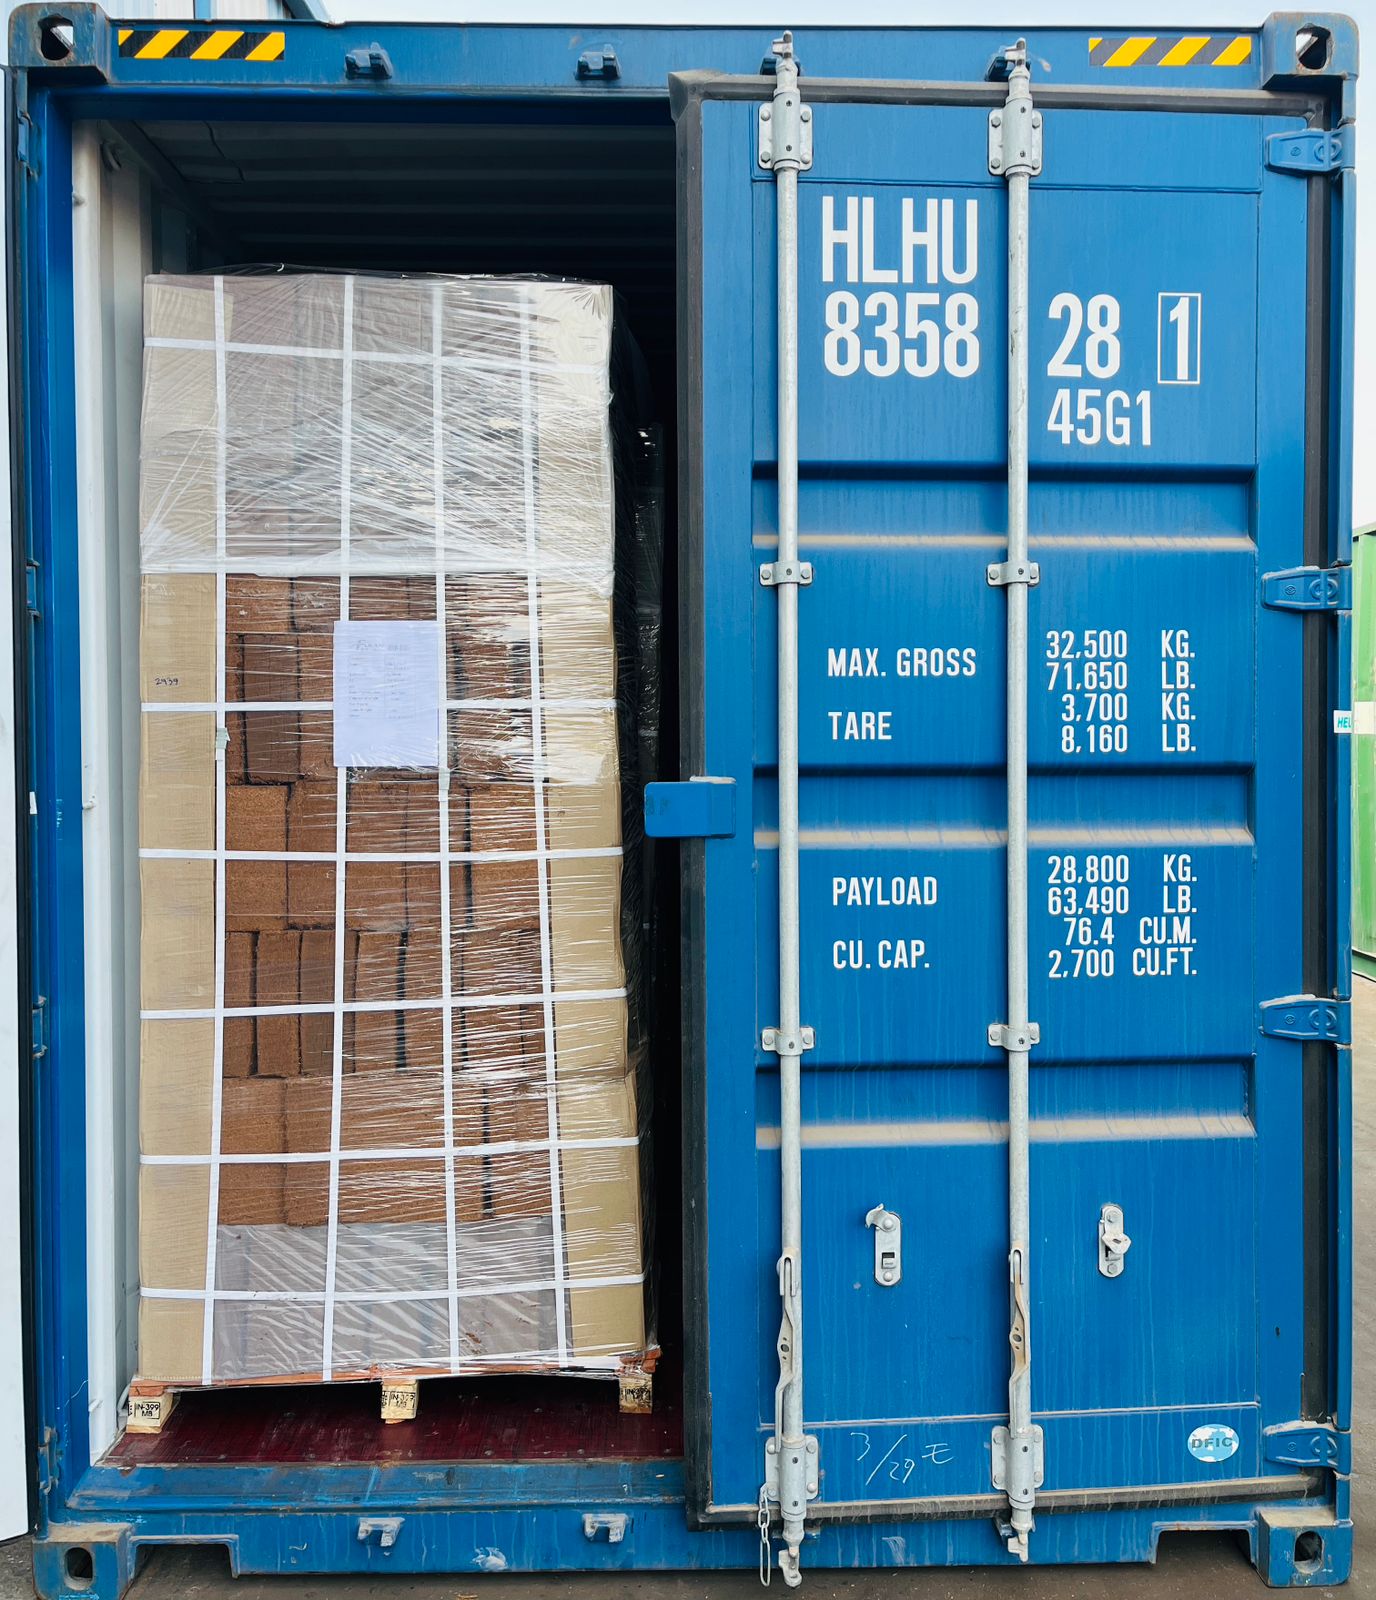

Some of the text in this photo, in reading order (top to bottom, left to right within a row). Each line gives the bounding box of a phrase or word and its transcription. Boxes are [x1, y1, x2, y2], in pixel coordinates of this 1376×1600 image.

[821, 195, 979, 286] HLHU
[823, 290, 1190, 381] 8358 28 1
[1047, 388, 1152, 448] 45G1
[1046, 629, 1196, 660] 32,500 KG.
[827, 648, 977, 678] MAX. GROSS
[1046, 661, 1196, 691] 71,650 LB.
[1061, 692, 1197, 722] 3,700 KG.
[828, 711, 892, 740] TARE
[1061, 724, 1197, 754] 8,160 LB.
[1047, 854, 1198, 884] 28,800 KG.
[832, 876, 938, 906] PAYLOAD
[1047, 885, 1198, 916] 63,490 LB.
[1063, 916, 1197, 946] 76.4 CU.M.
[833, 940, 930, 970] CU. CAP.
[1048, 947, 1198, 979] 2,700 CU.FT.
[1191, 1437, 1233, 1449] DFIC
